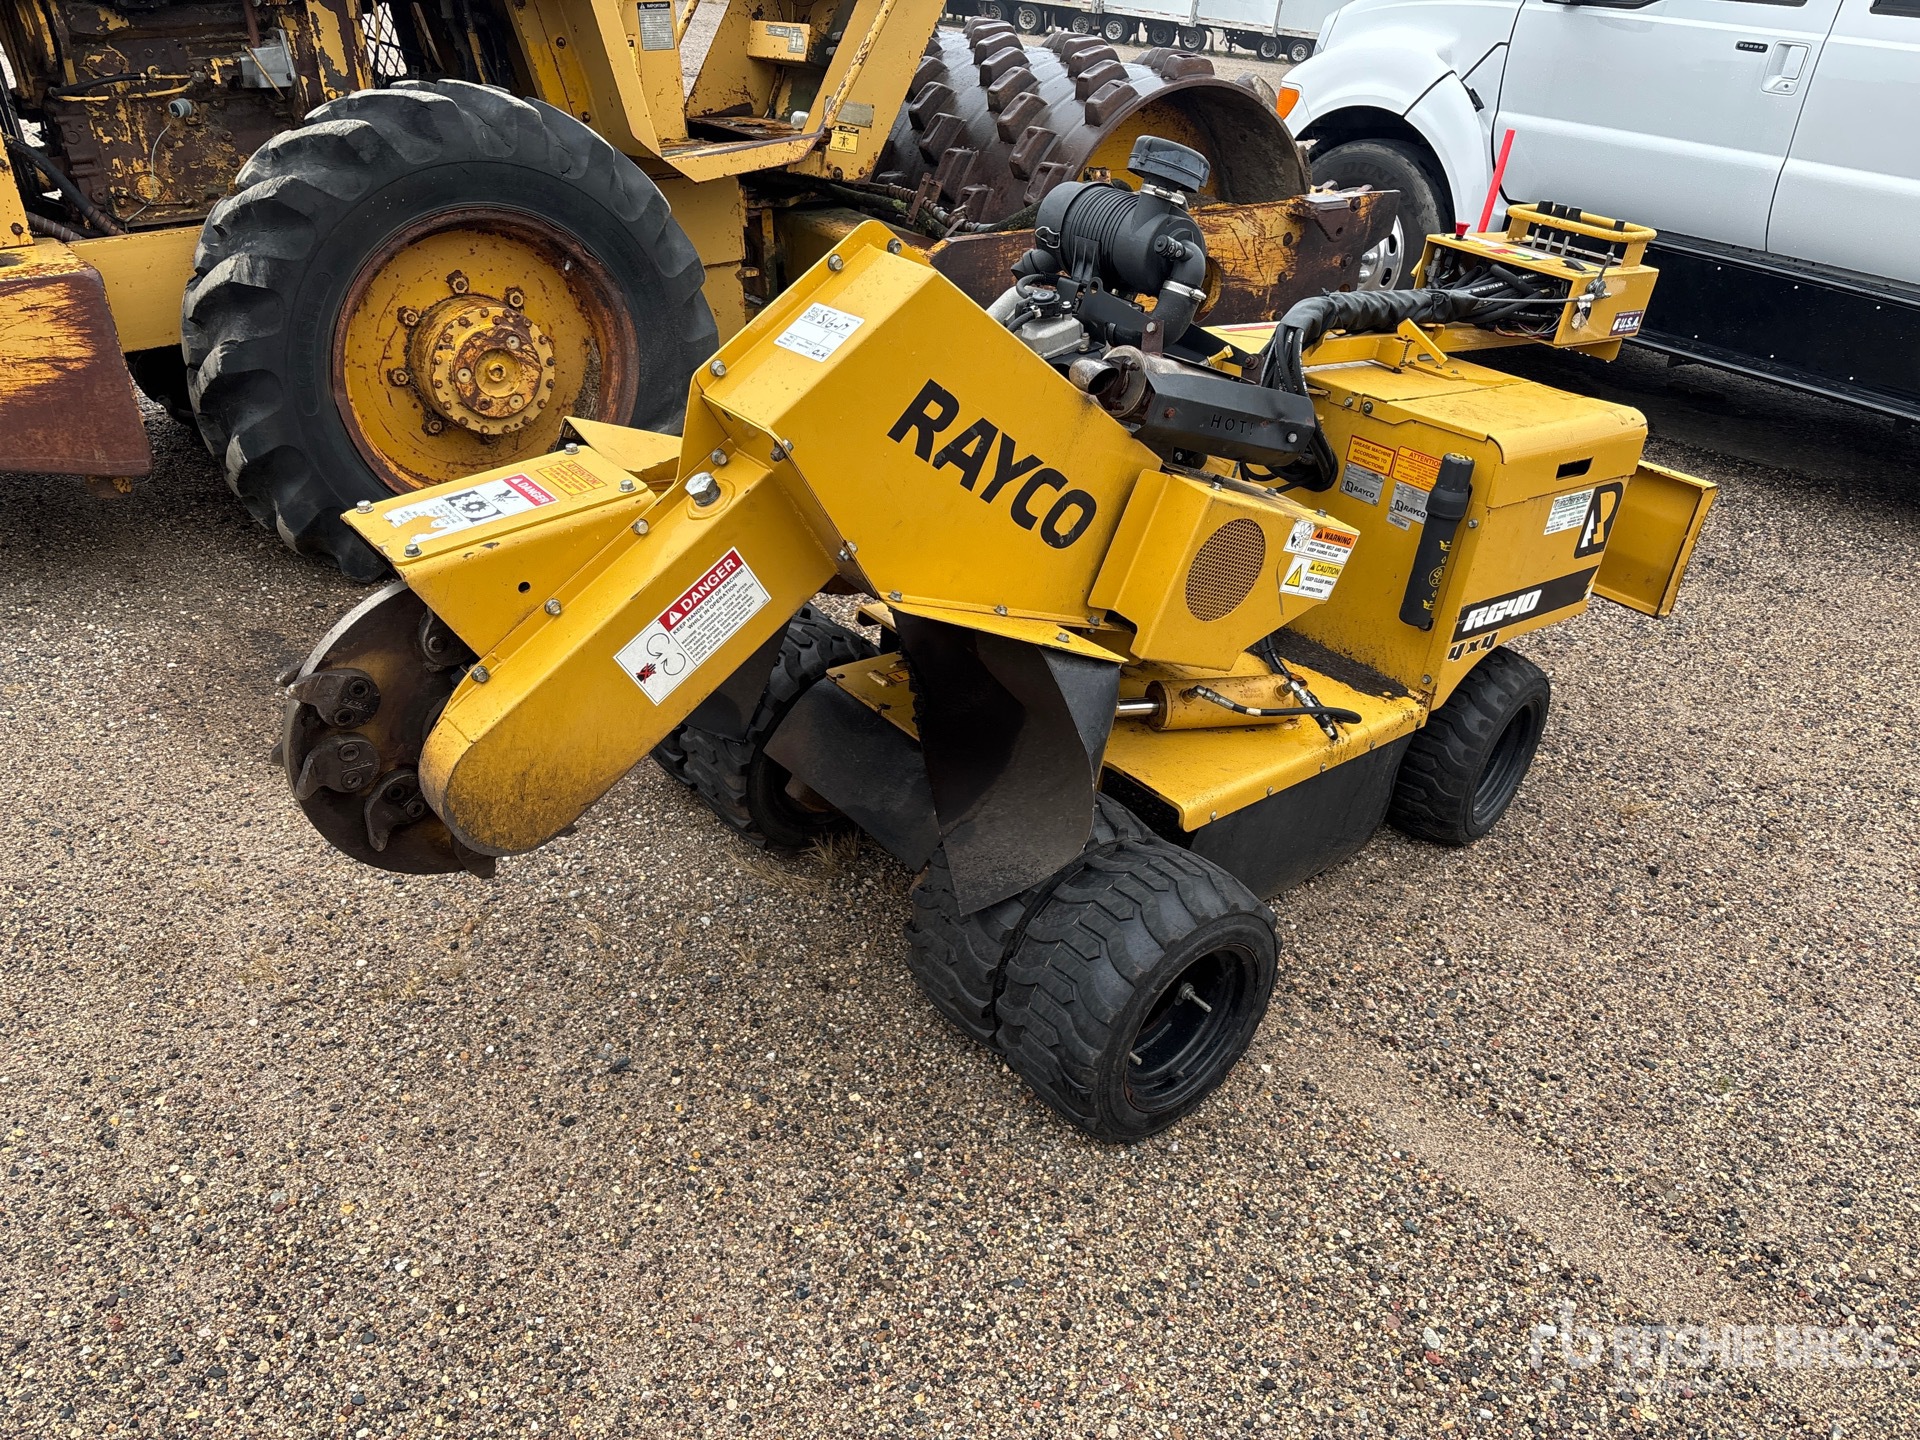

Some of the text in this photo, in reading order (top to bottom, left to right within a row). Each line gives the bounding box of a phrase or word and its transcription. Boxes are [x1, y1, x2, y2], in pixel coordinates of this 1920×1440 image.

[1210, 414, 1254, 436] HOT!
[1352, 440, 1391, 457] GREASE MACHINE
[1354, 448, 1379, 460] ACCORDING
[887, 379, 1097, 549] RAYCO
[1352, 455, 1384, 470] INSTRUCTIONS
[515, 482, 551, 503] DANGER
[1353, 485, 1374, 498] RAYCO
[1403, 505, 1425, 518] RAYCO
[1323, 531, 1351, 544] WARNING
[1315, 564, 1340, 575] CAUTION
[680, 557, 736, 611] DANGER
[672, 567, 744, 635] KEEP HANDS OUT OF MACHINE
[687, 613, 703, 629] WHILE
[709, 582, 737, 609] OPERATION
[1462, 589, 1543, 632] RG40
